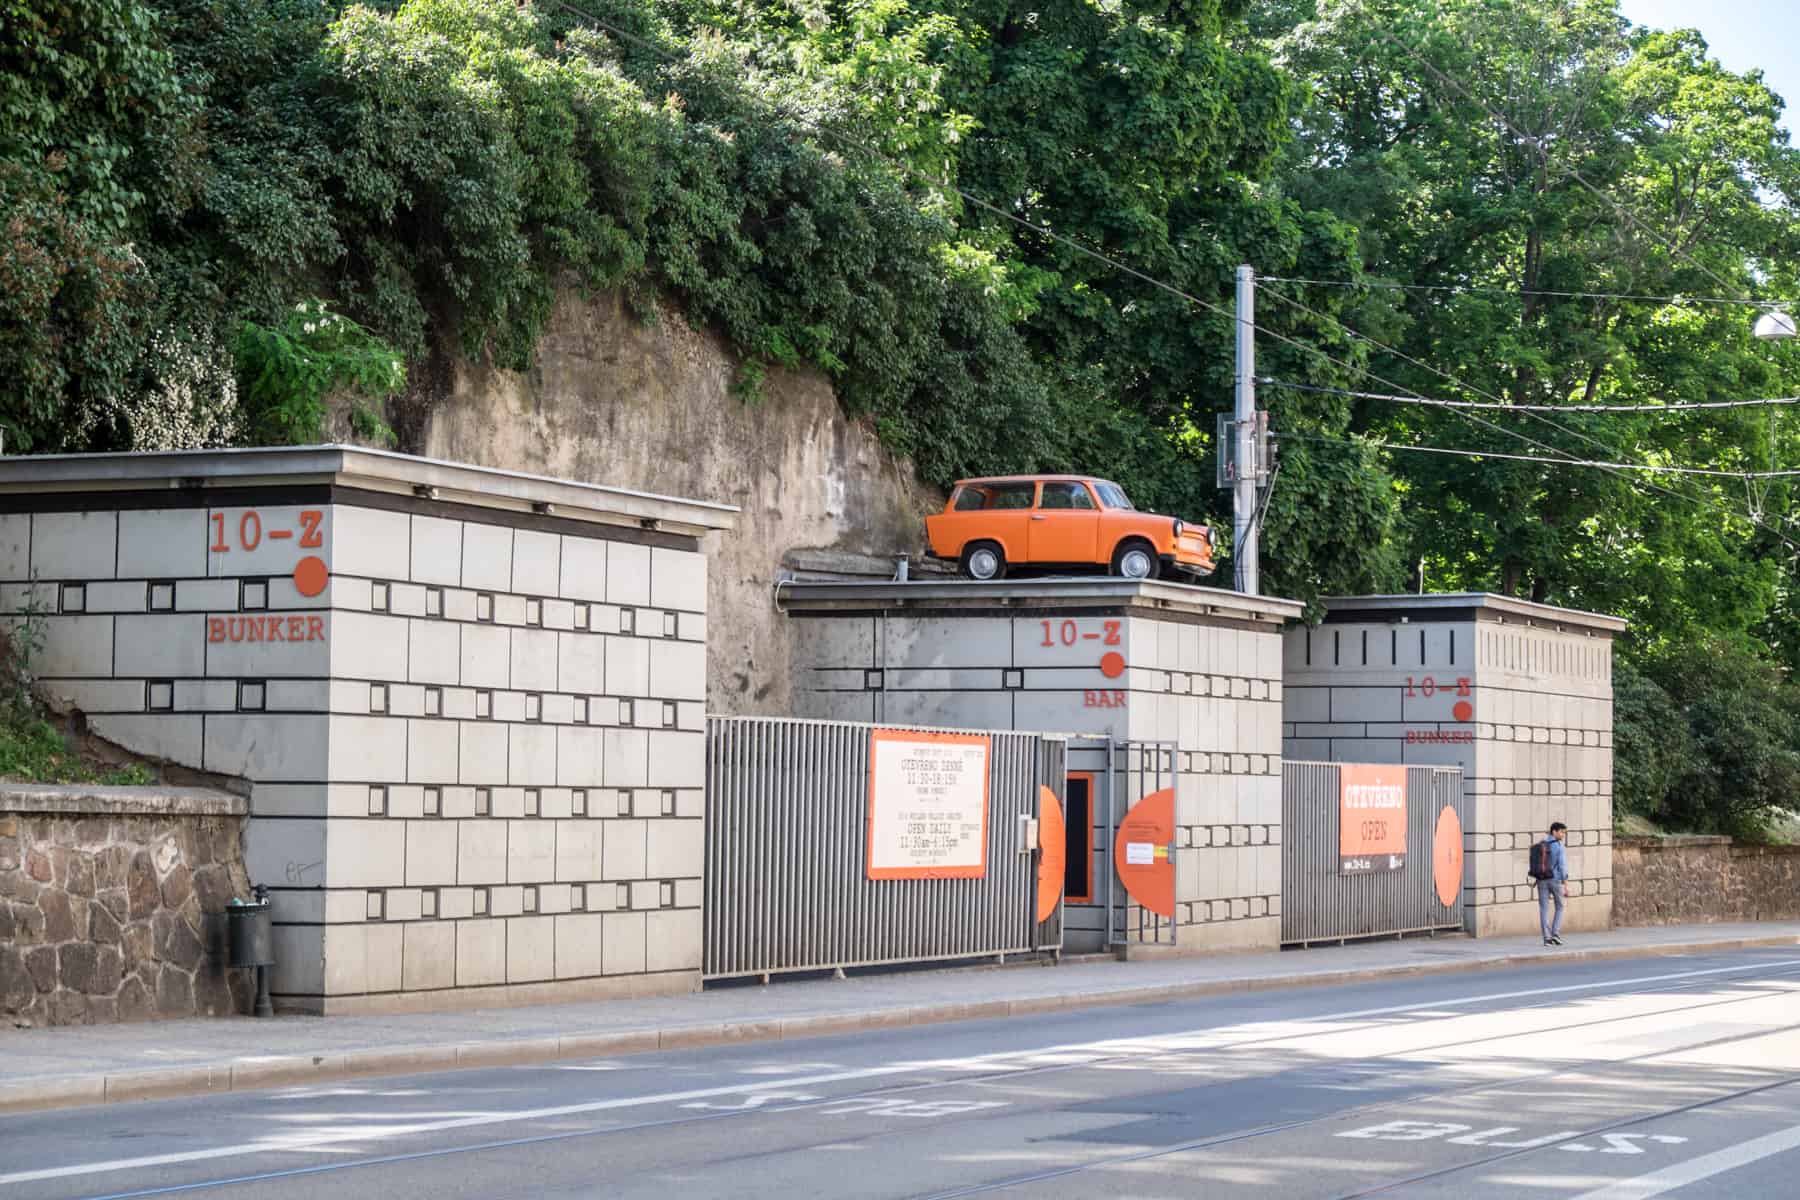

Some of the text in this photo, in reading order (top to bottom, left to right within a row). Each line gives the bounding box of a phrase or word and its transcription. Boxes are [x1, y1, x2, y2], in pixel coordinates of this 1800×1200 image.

[209, 510, 323, 553] 10-Z
[208, 616, 325, 643] BUNKER
[1040, 619, 1121, 647] 10-Z
[1083, 688, 1127, 708] BAR
[1406, 730, 1473, 744] BUNKER
[907, 823, 926, 834] OPEN
[929, 823, 952, 834] DAILY
[1361, 821, 1387, 841] OPEN
[1332, 1120, 1688, 1154] BUS
